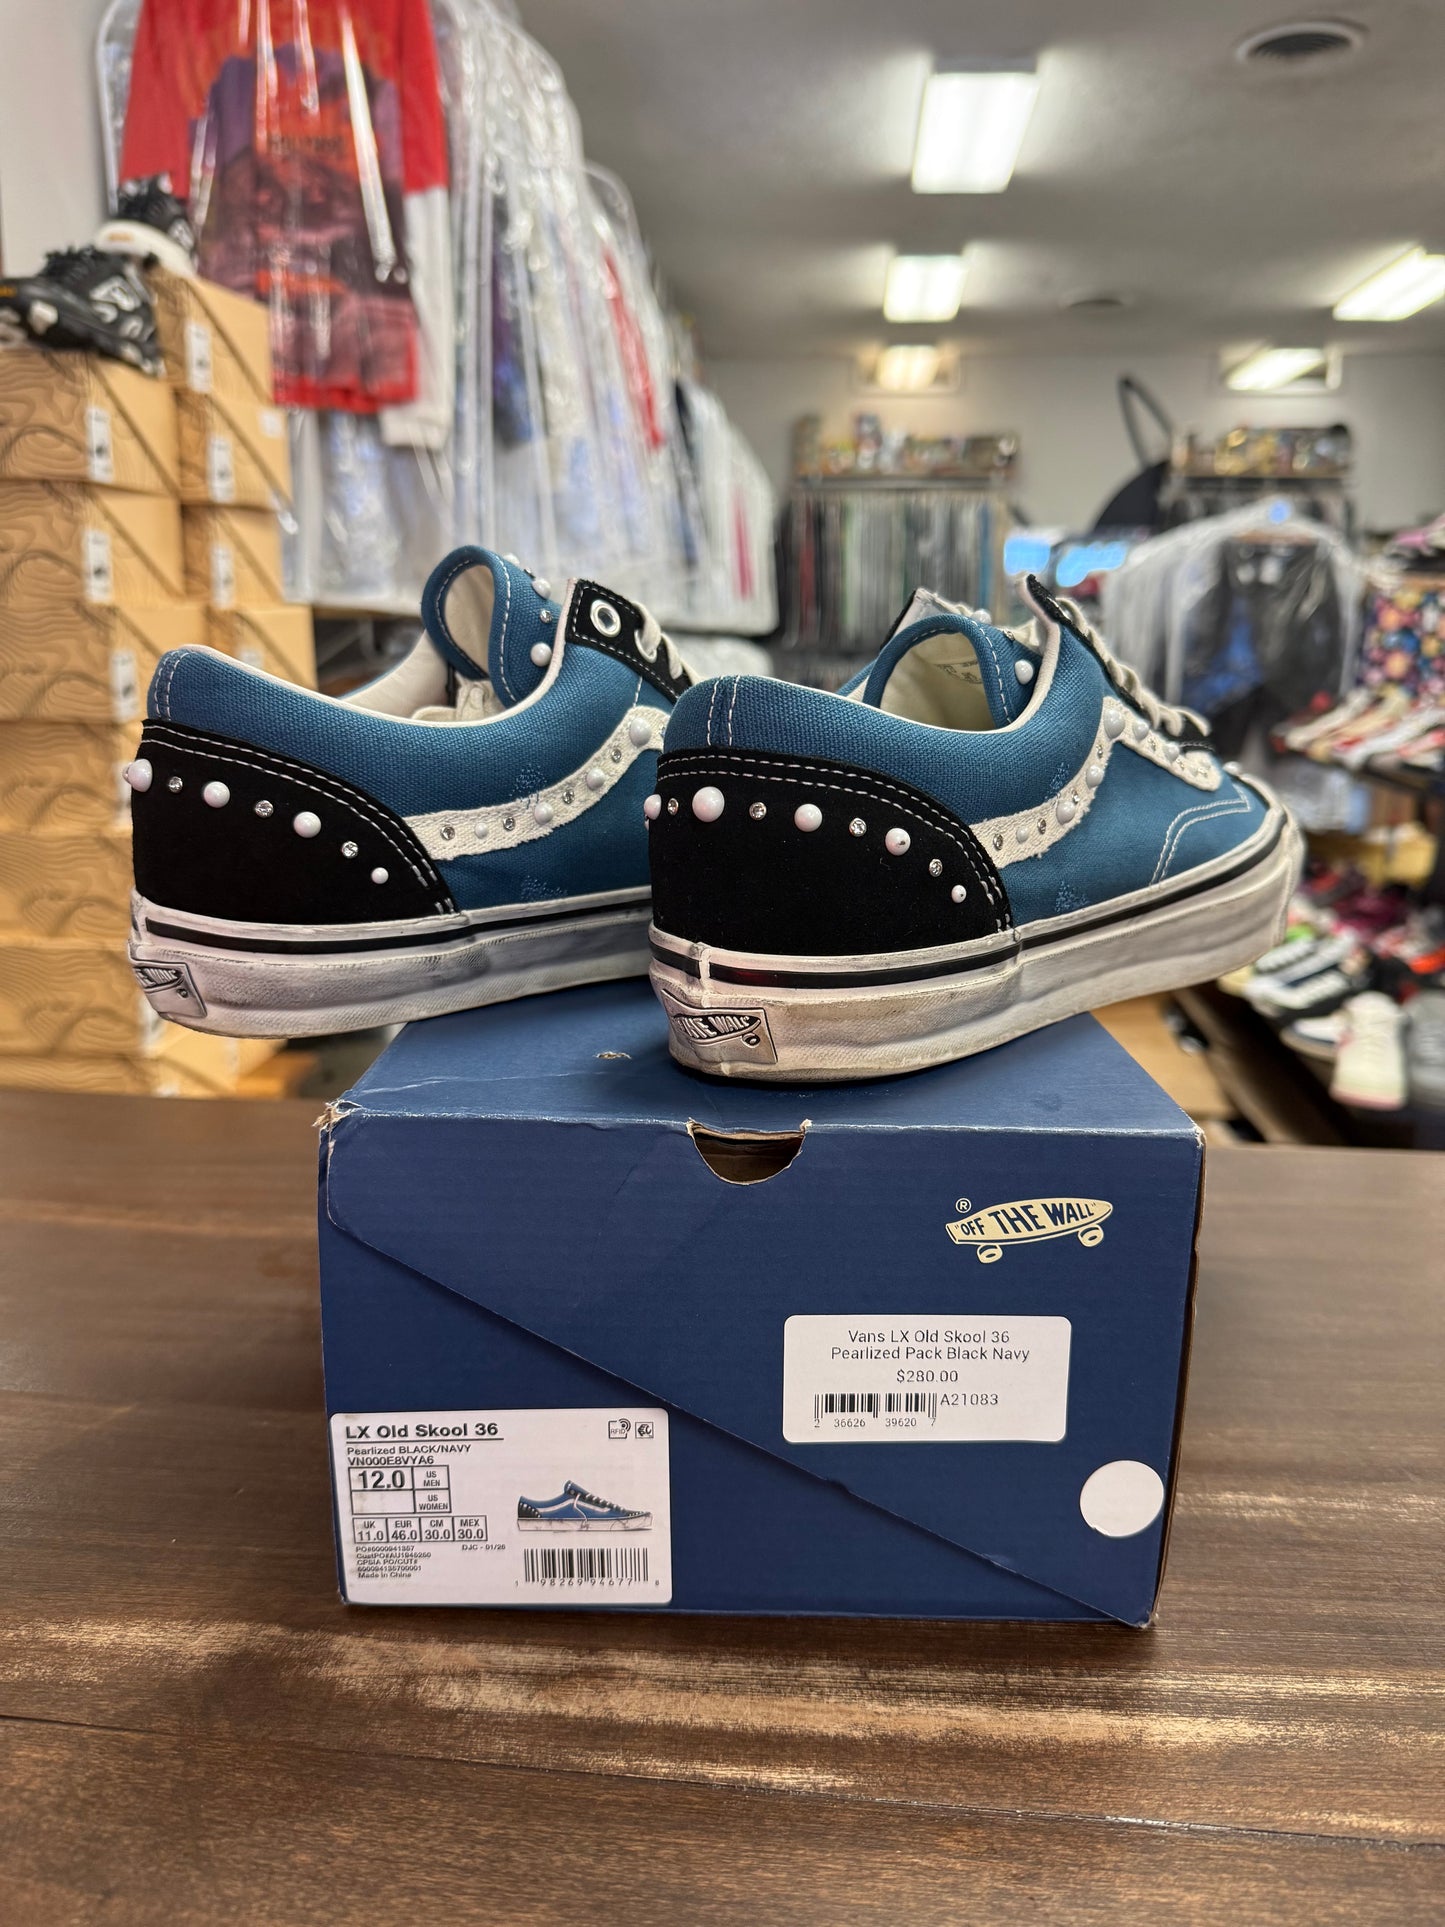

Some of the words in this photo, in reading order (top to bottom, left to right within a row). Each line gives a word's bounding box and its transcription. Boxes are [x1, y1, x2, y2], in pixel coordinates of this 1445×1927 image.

[987, 1204, 1046, 1234] THE
[848, 1330, 885, 1343] Vans
[891, 1330, 910, 1343] LX
[914, 1330, 939, 1343] Old
[944, 1330, 986, 1343] Skool
[991, 1331, 1010, 1344] 36
[831, 1346, 900, 1360] Pearlized
[905, 1346, 942, 1360] Pack
[947, 1346, 988, 1360] Black
[993, 1347, 1030, 1363] Navy
[896, 1369, 958, 1384] $280.00
[940, 1394, 999, 1406] A21083
[814, 1418, 820, 1428] 2
[834, 1418, 866, 1428] 36626
[885, 1418, 917, 1428] 39620
[930, 1418, 936, 1428] 7
[346, 1425, 370, 1439] LX
[376, 1424, 408, 1438] Old
[416, 1423, 468, 1438] Skool
[474, 1422, 498, 1436] 36
[347, 1446, 396, 1456] Pearlized
[400, 1444, 472, 1454] BLACK/NAVY
[348, 1456, 434, 1466] VN000E8VYA6
[358, 1470, 406, 1489] 12.0
[426, 1470, 437, 1478] US
[428, 1494, 438, 1502] US
[419, 1502, 448, 1510] WOMEN
[364, 1520, 376, 1528] UK
[395, 1520, 412, 1528] EUR
[460, 1519, 480, 1527] MEX
[358, 1530, 384, 1541] 11.0
[392, 1530, 418, 1540] 46.0
[424, 1529, 451, 1540] 30.0
[458, 1528, 484, 1540] 30.0
[540, 1578, 583, 1586] 98269
[590, 1578, 633, 1586] 94677
